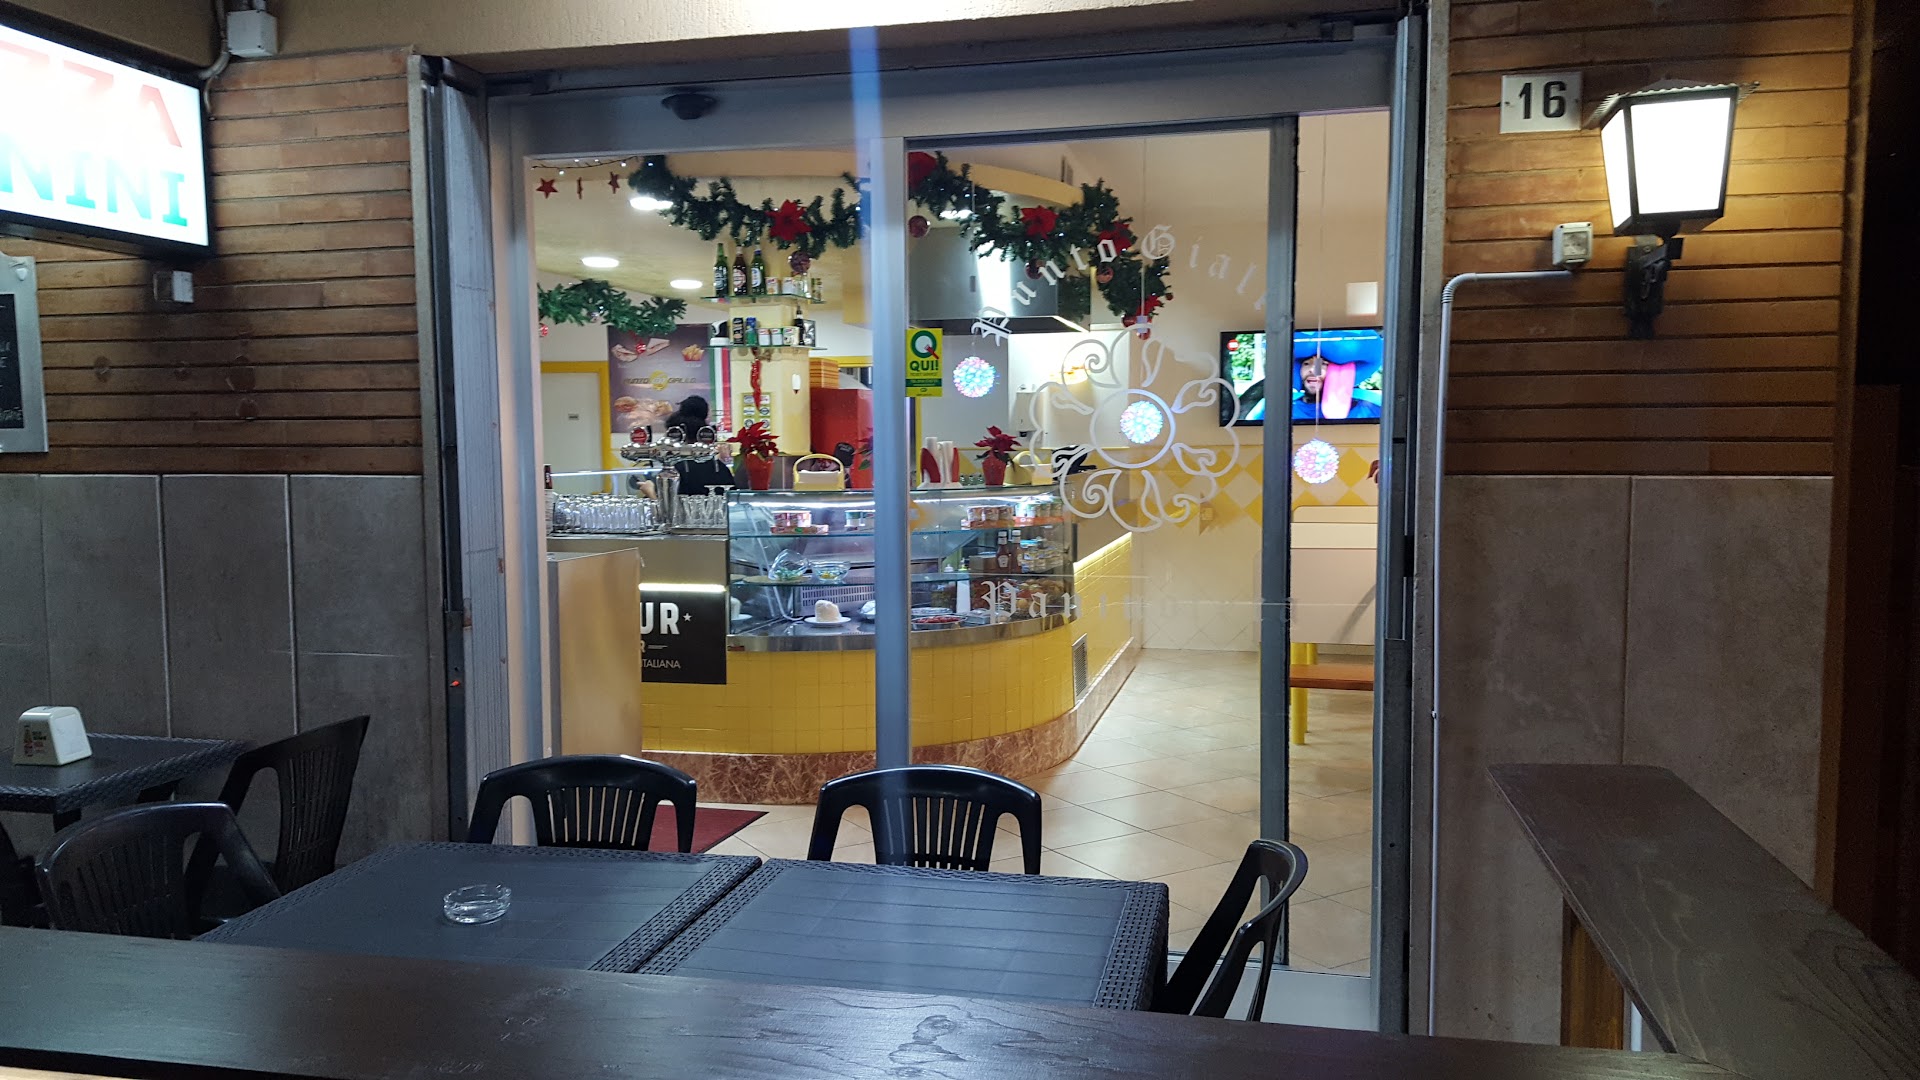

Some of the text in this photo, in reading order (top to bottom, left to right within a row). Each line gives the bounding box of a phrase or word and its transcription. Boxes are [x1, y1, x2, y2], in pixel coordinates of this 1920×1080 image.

[1519, 81, 1567, 119] 16
[971, 225, 1268, 346] Punto Giall
[910, 360, 939, 372] QUI!
[641, 659, 681, 669] TALIANA
